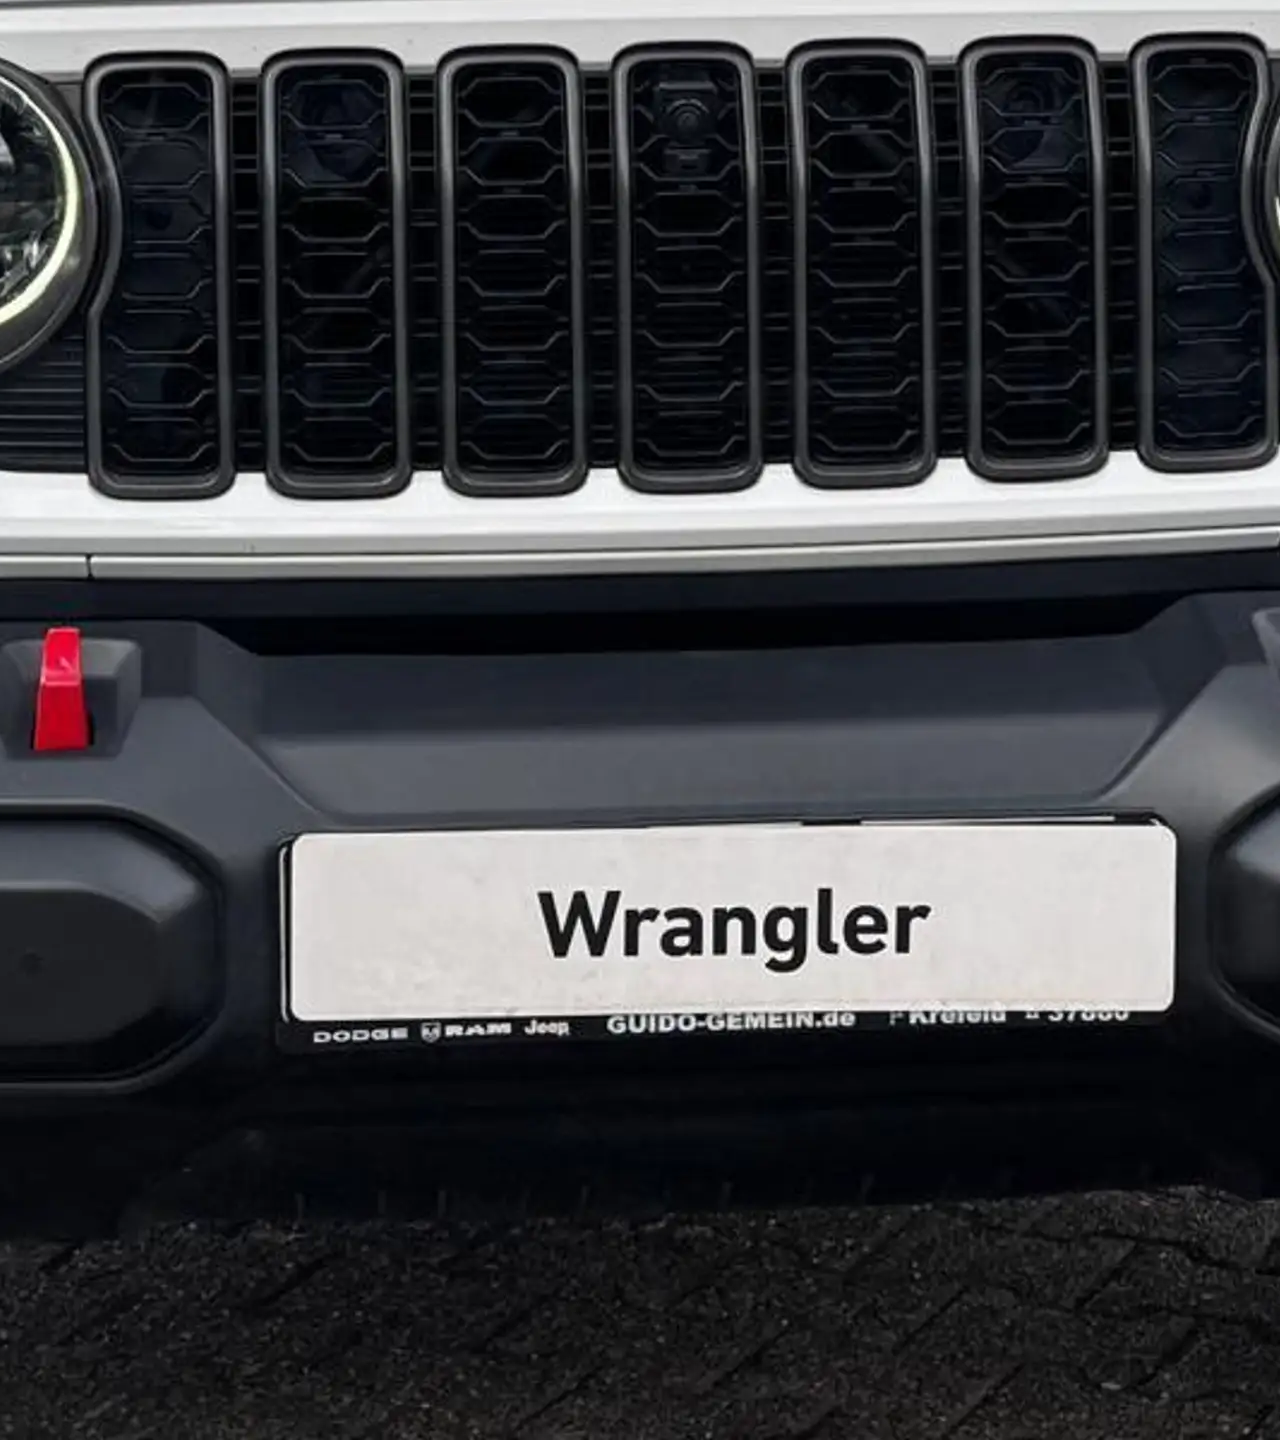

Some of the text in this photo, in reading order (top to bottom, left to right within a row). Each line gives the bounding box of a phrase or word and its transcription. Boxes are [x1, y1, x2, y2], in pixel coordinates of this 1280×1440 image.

[538, 888, 932, 973] Wrangler
[313, 1019, 570, 1043] DODGE RAM Jeep
[606, 1011, 857, 1034] GUIDO-GEMEIN.de
